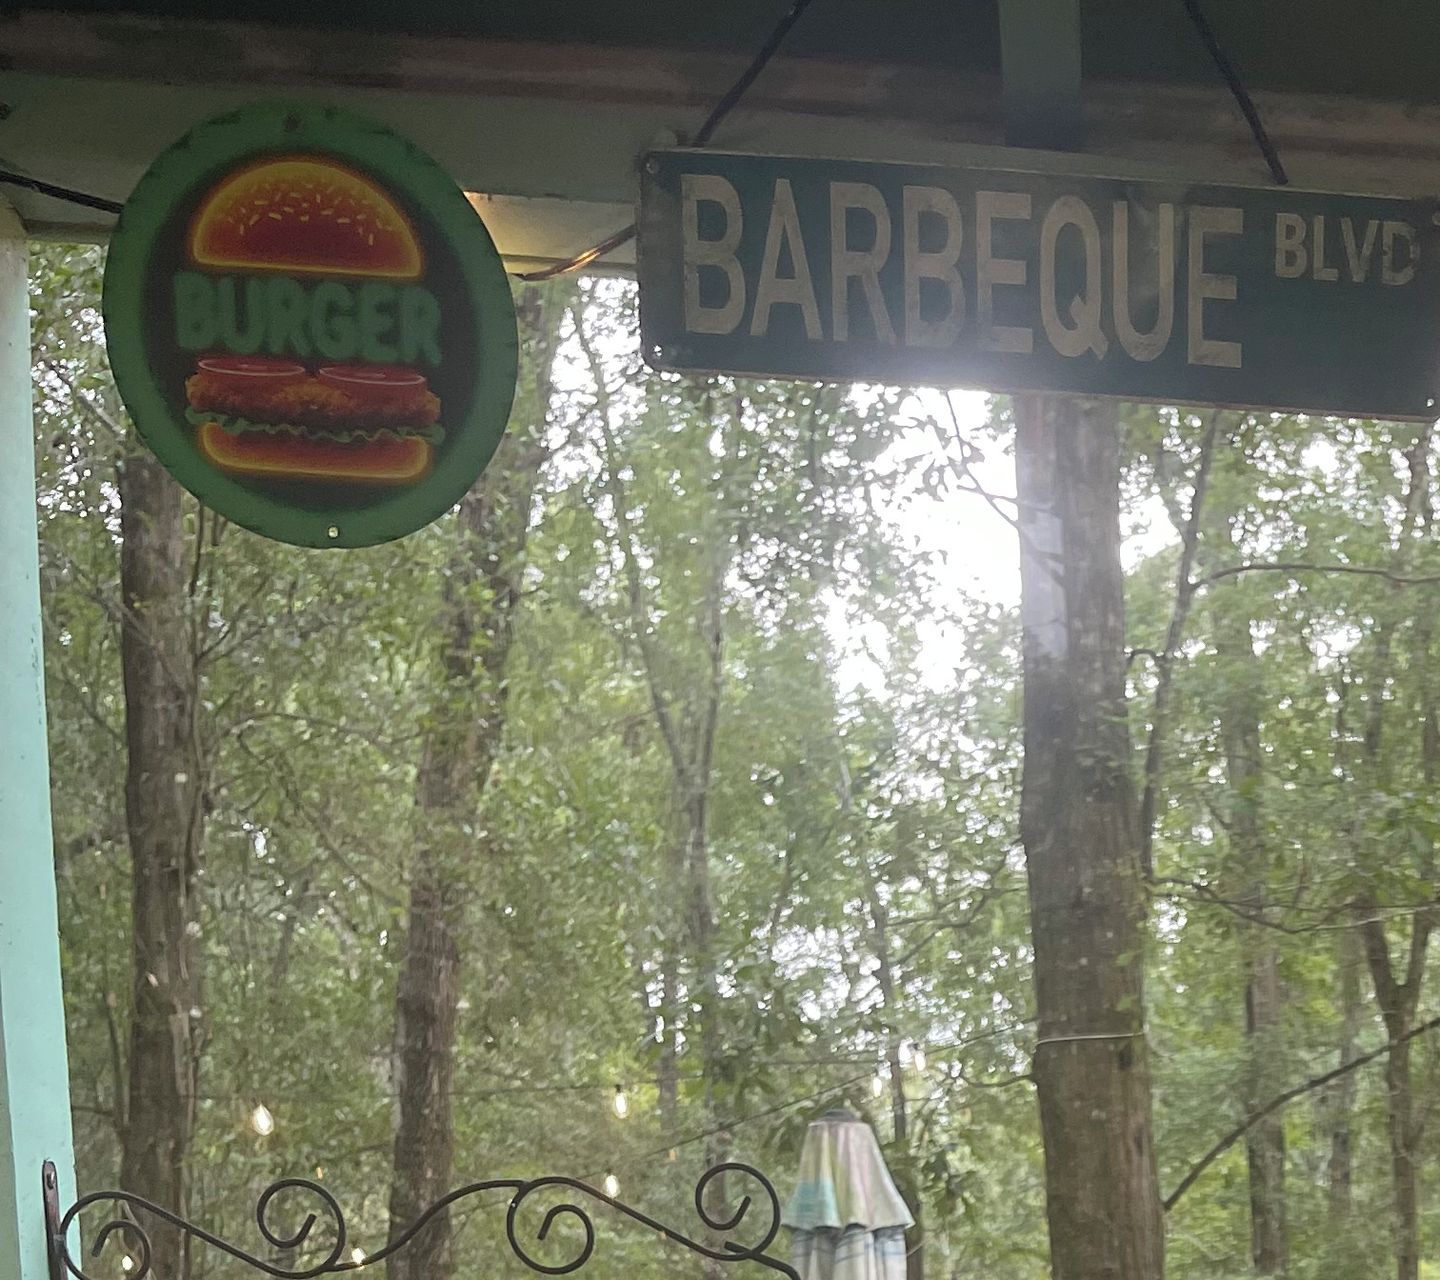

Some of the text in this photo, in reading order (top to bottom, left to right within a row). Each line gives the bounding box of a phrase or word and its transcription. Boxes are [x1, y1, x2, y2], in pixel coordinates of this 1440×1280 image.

[174, 270, 444, 367] BURGER
[680, 173, 1421, 369] BARBEQUE BLVD
